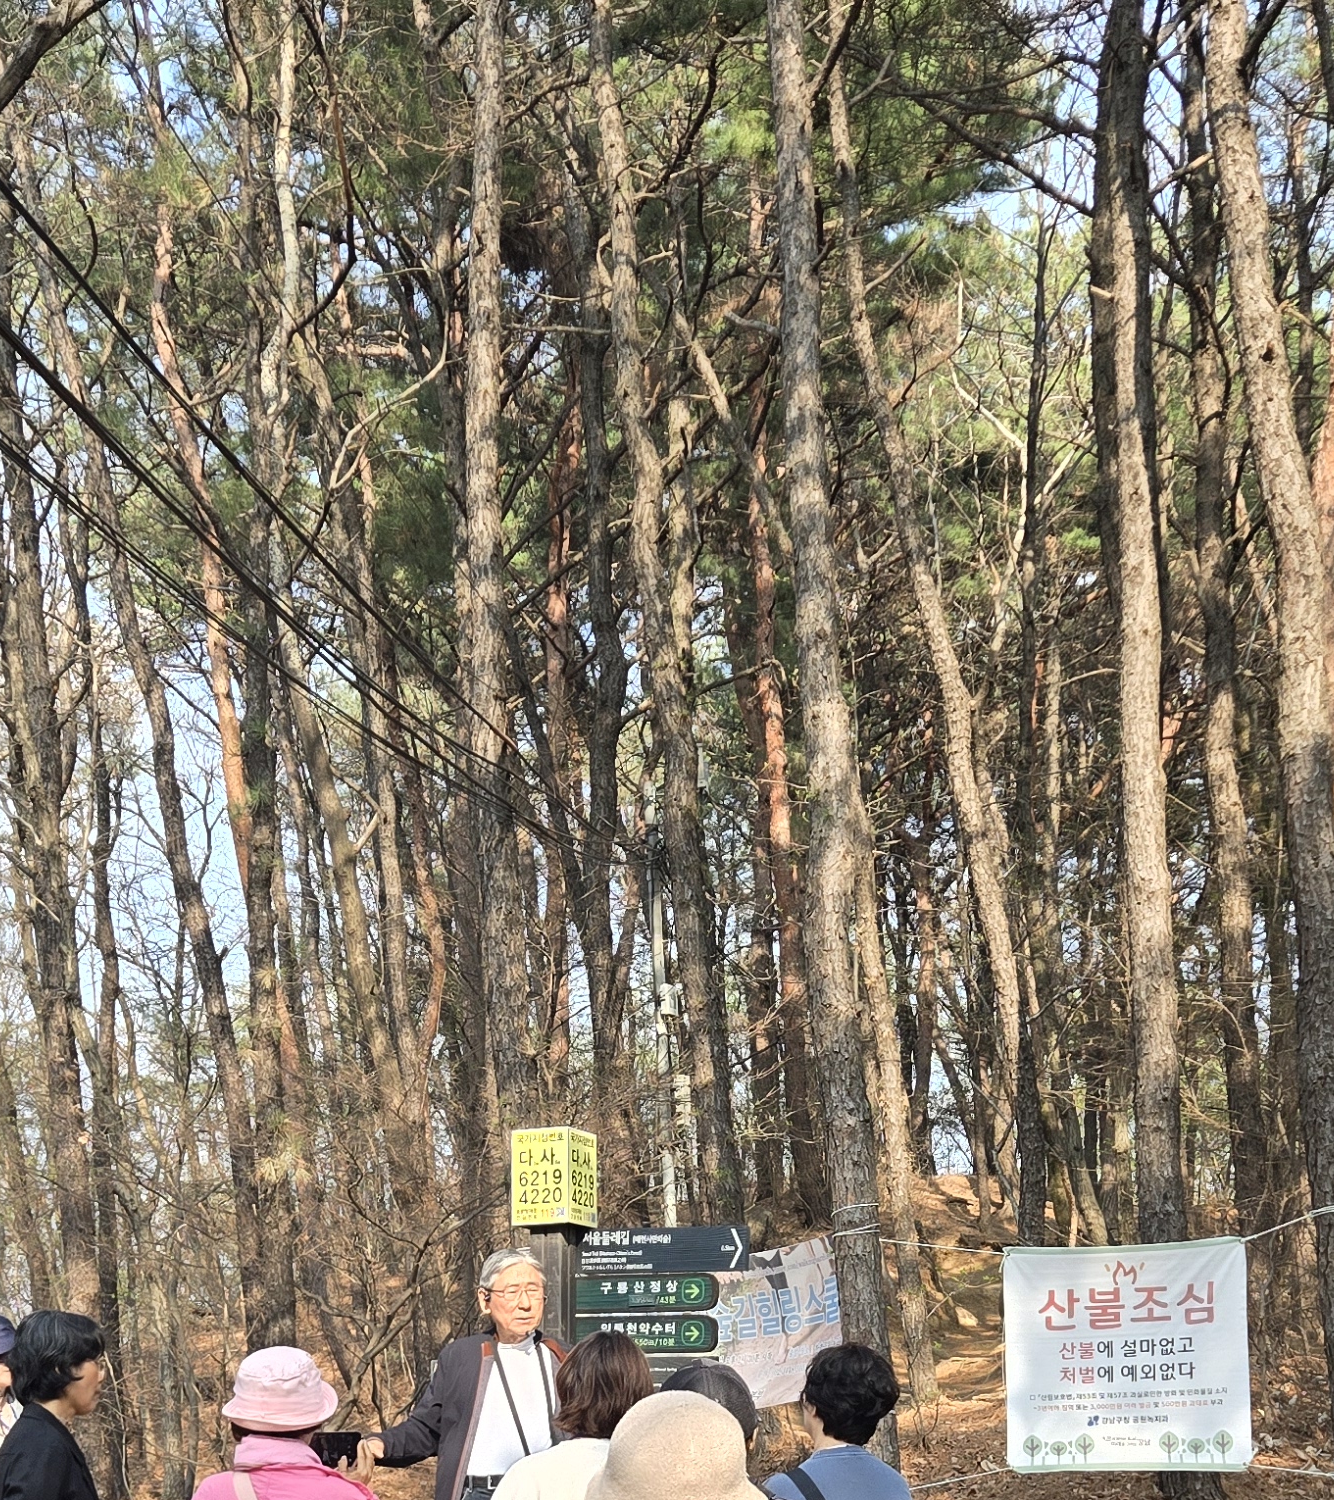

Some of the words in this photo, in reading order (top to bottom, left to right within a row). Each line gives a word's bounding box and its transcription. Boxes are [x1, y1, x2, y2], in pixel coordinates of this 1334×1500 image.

[517, 1132, 564, 1144] 국가지점번호
[519, 1169, 562, 1187] 6219
[571, 1169, 595, 1190] 6219
[519, 1187, 562, 1204] 4220
[571, 1188, 595, 1208] 4220
[582, 1230, 630, 1246] 서울둘레길
[1038, 1281, 1214, 1331] 산불조심
[1059, 1340, 1113, 1360] 산불에
[1121, 1337, 1195, 1358] 설마없고
[1059, 1366, 1114, 1384] 처벌에
[1121, 1362, 1196, 1382] 예외없다
